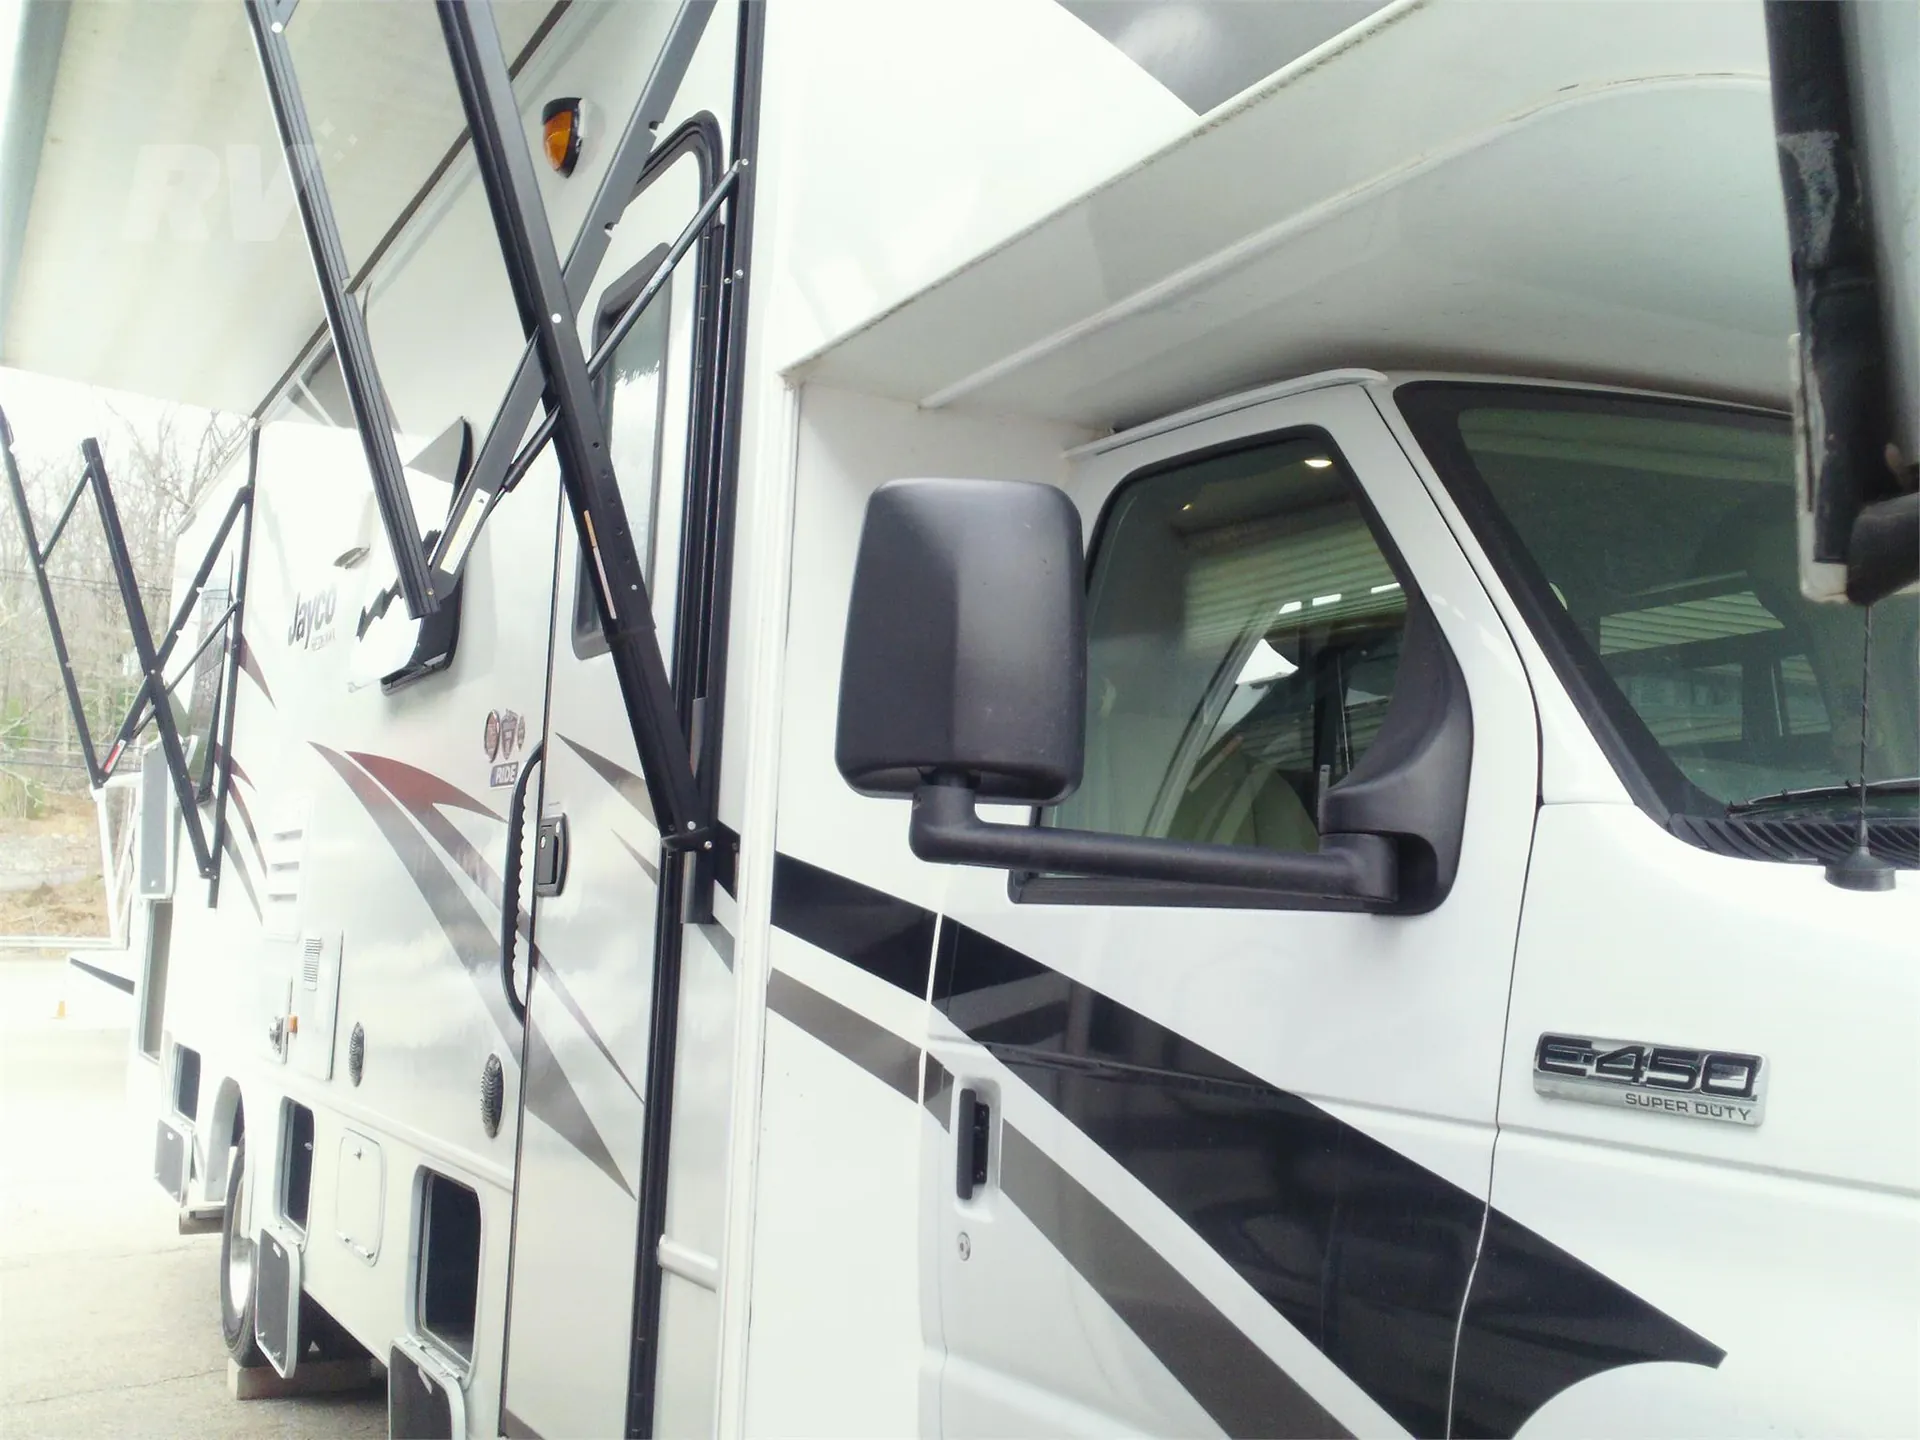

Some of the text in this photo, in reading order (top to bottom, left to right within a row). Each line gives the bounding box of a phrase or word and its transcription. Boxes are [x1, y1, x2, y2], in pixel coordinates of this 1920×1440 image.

[288, 587, 337, 649] Jayco
[1538, 1035, 1759, 1099] E-450
[1625, 1092, 1751, 1121] SUPER DUTY
